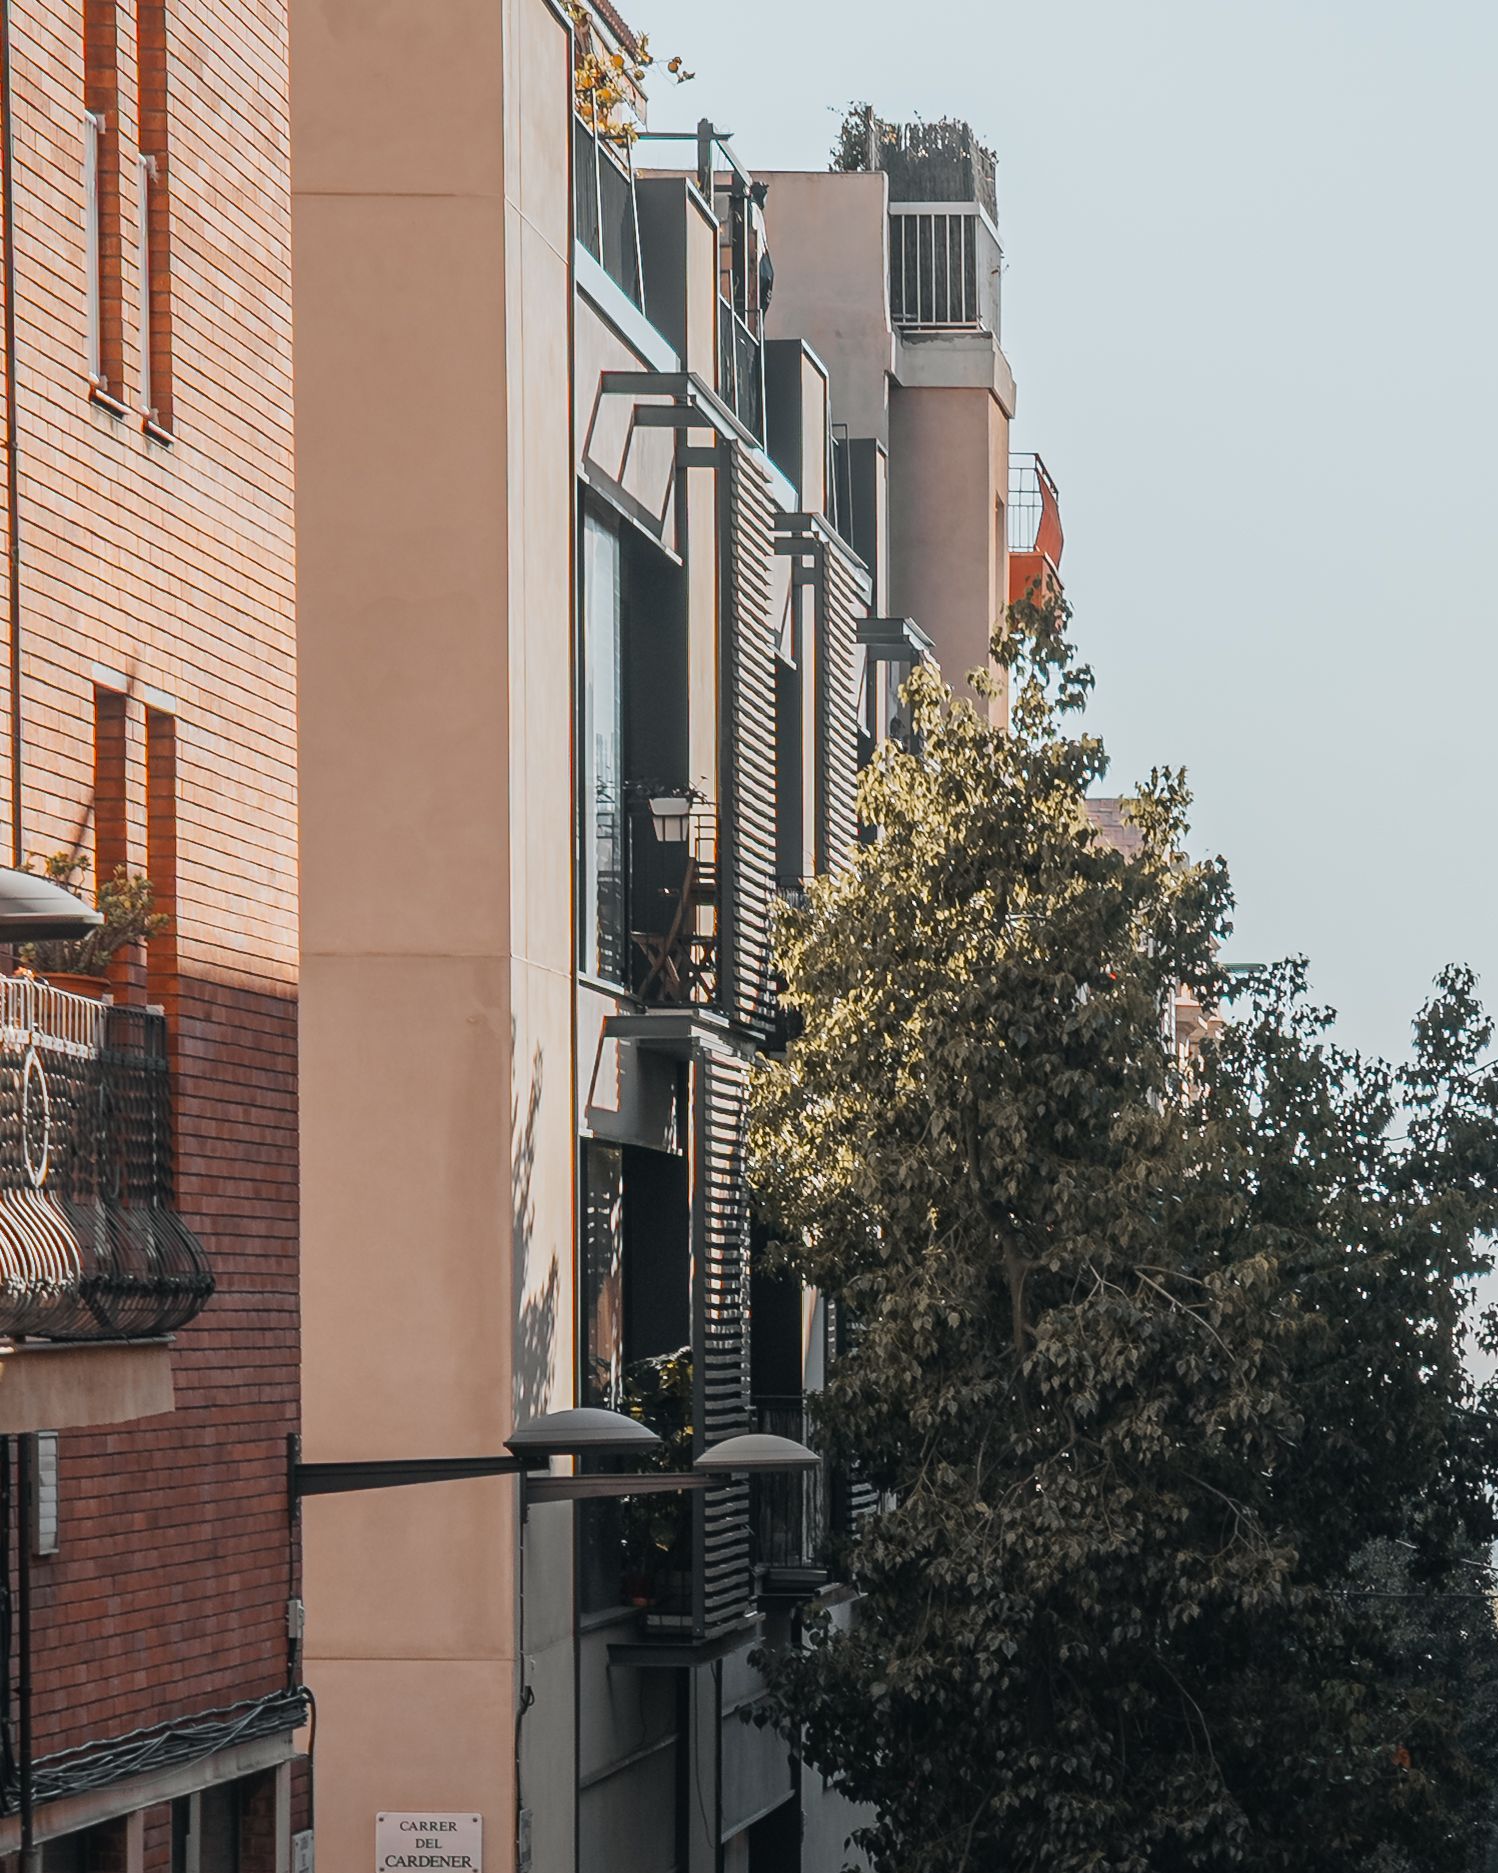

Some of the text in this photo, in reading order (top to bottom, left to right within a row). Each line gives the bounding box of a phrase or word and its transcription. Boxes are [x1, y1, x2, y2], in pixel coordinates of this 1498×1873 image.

[399, 1821, 457, 1832] CARRER
[416, 1838, 442, 1849] DEL
[385, 1855, 472, 1868] CARDENER
